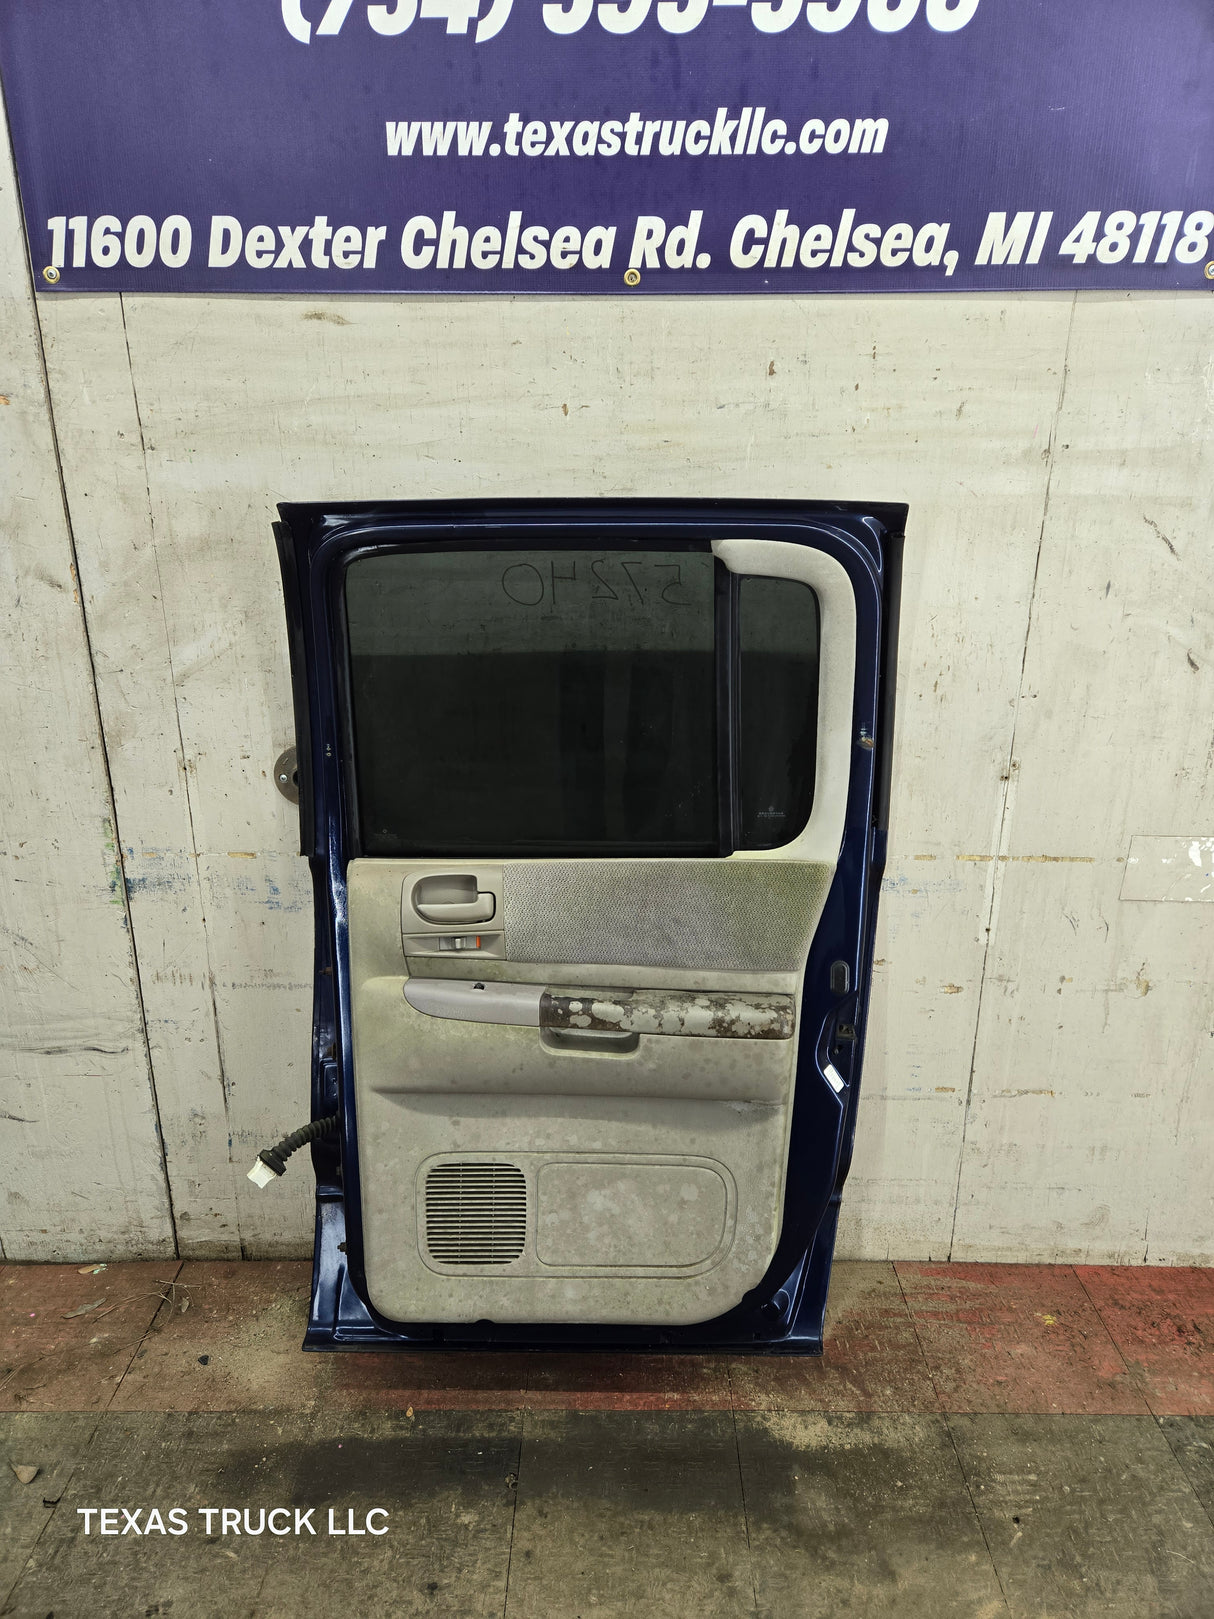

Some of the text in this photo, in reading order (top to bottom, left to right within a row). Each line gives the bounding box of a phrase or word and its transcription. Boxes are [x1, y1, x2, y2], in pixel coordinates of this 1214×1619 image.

[385, 106, 890, 157] www.texastruckllc.com
[46, 208, 1214, 277] 11600 Dexter Chelsea Rd. Chelsea, MI 48118
